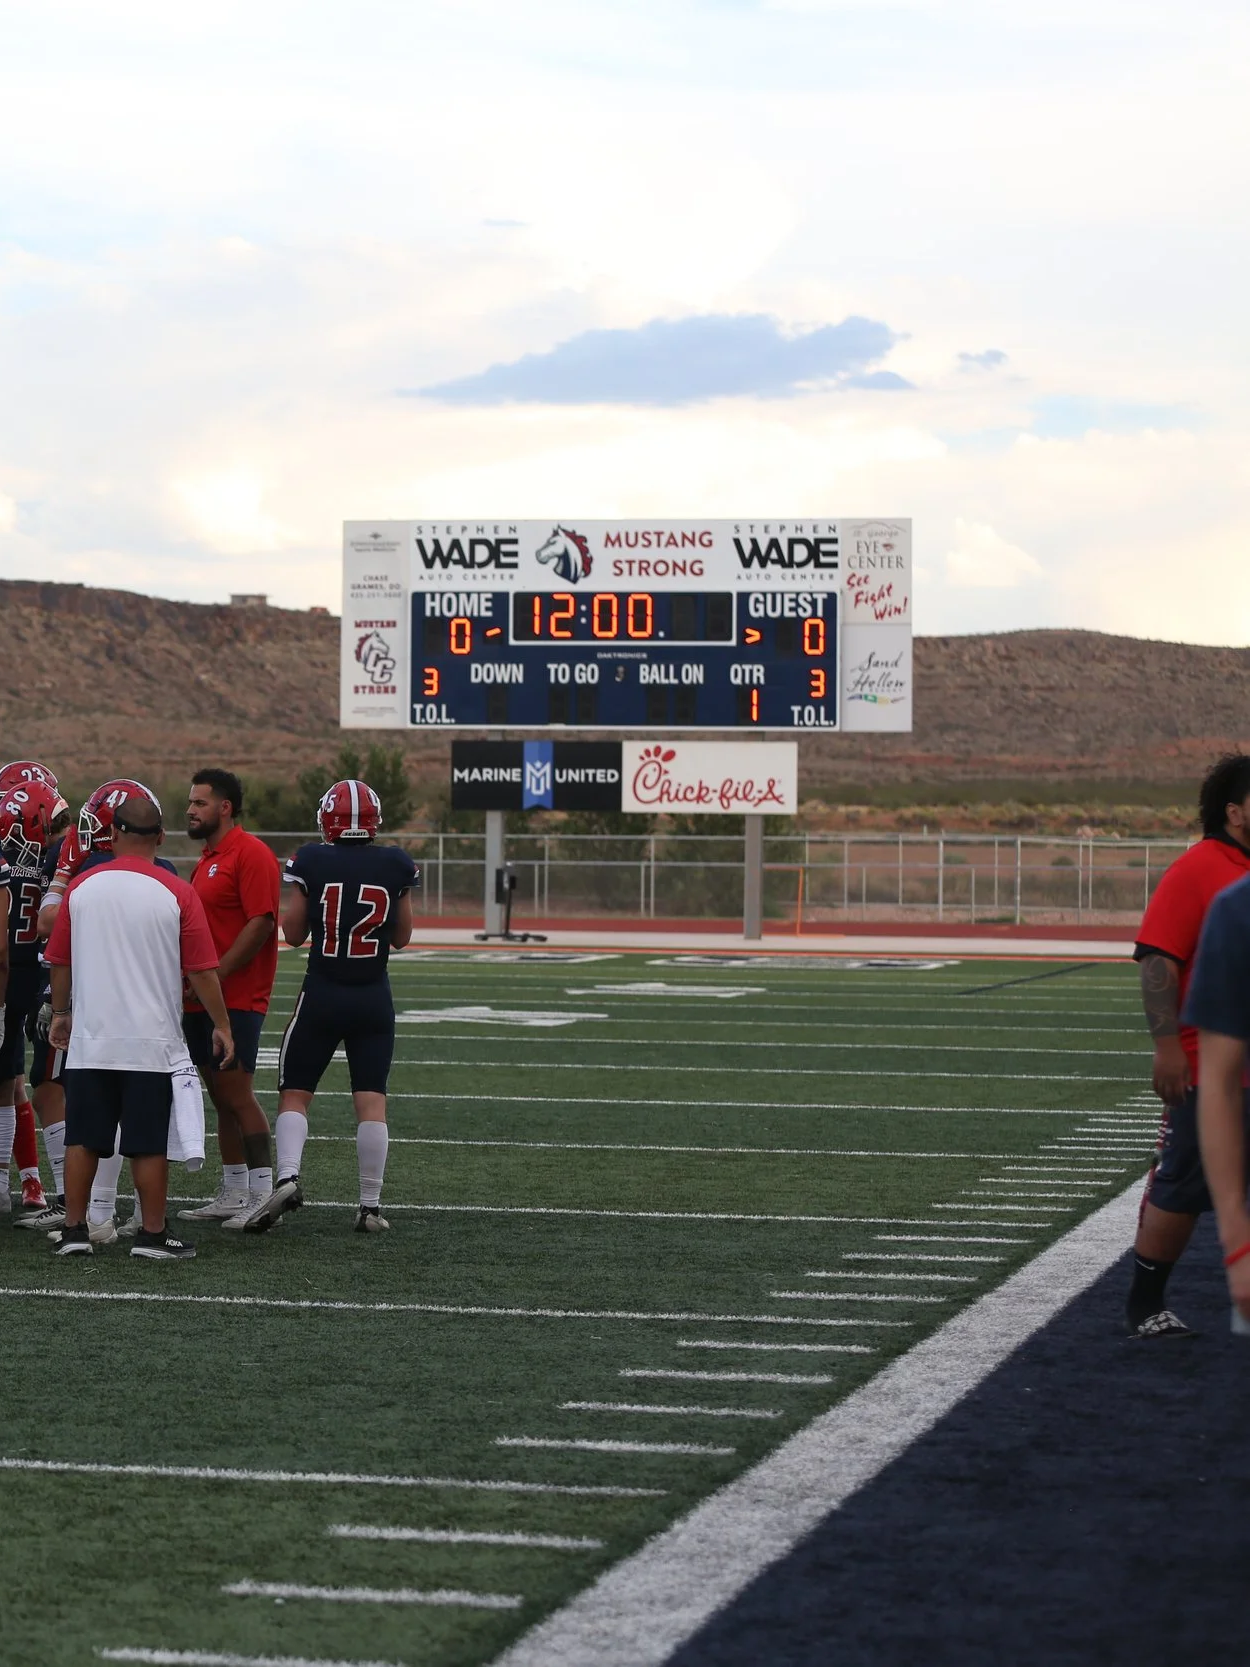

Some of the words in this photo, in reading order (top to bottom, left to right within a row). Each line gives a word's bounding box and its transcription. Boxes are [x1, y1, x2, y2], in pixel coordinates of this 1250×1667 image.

[416, 525, 518, 535] STEPHEN
[734, 524, 837, 534] STEPHEN
[604, 531, 713, 549] MUSTANG
[856, 541, 879, 554] EYE
[415, 538, 519, 569] WADE
[732, 537, 839, 569] WADE
[847, 555, 905, 569] CENTER
[419, 573, 453, 581] AUTO
[462, 573, 515, 581] CENTER
[613, 560, 704, 577] STRONG
[736, 573, 772, 581] AUTO
[780, 573, 835, 581] CENTER
[846, 572, 870, 590] See
[425, 593, 493, 617] HOME
[748, 593, 828, 618] GUEST
[354, 620, 398, 628] MUSTANG
[450, 618, 471, 655] 0
[803, 618, 825, 656] 0
[423, 667, 440, 696] 3
[470, 663, 524, 684] DOWN
[547, 663, 570, 684] TO
[574, 663, 599, 684] GO
[639, 664, 678, 685] BALL
[681, 664, 704, 685] ON
[730, 664, 765, 685] QTR
[810, 669, 826, 698] 3
[413, 704, 456, 724] T.O.L.
[751, 688, 758, 722] 1
[791, 705, 835, 726] T.O.L.
[453, 767, 522, 783] MARINE
[555, 768, 620, 784] UNITED
[633, 759, 786, 810] Chick-fil-A
[106, 789, 129, 808] 41
[319, 882, 391, 958] 12
[165, 1238, 183, 1248] HOKA
